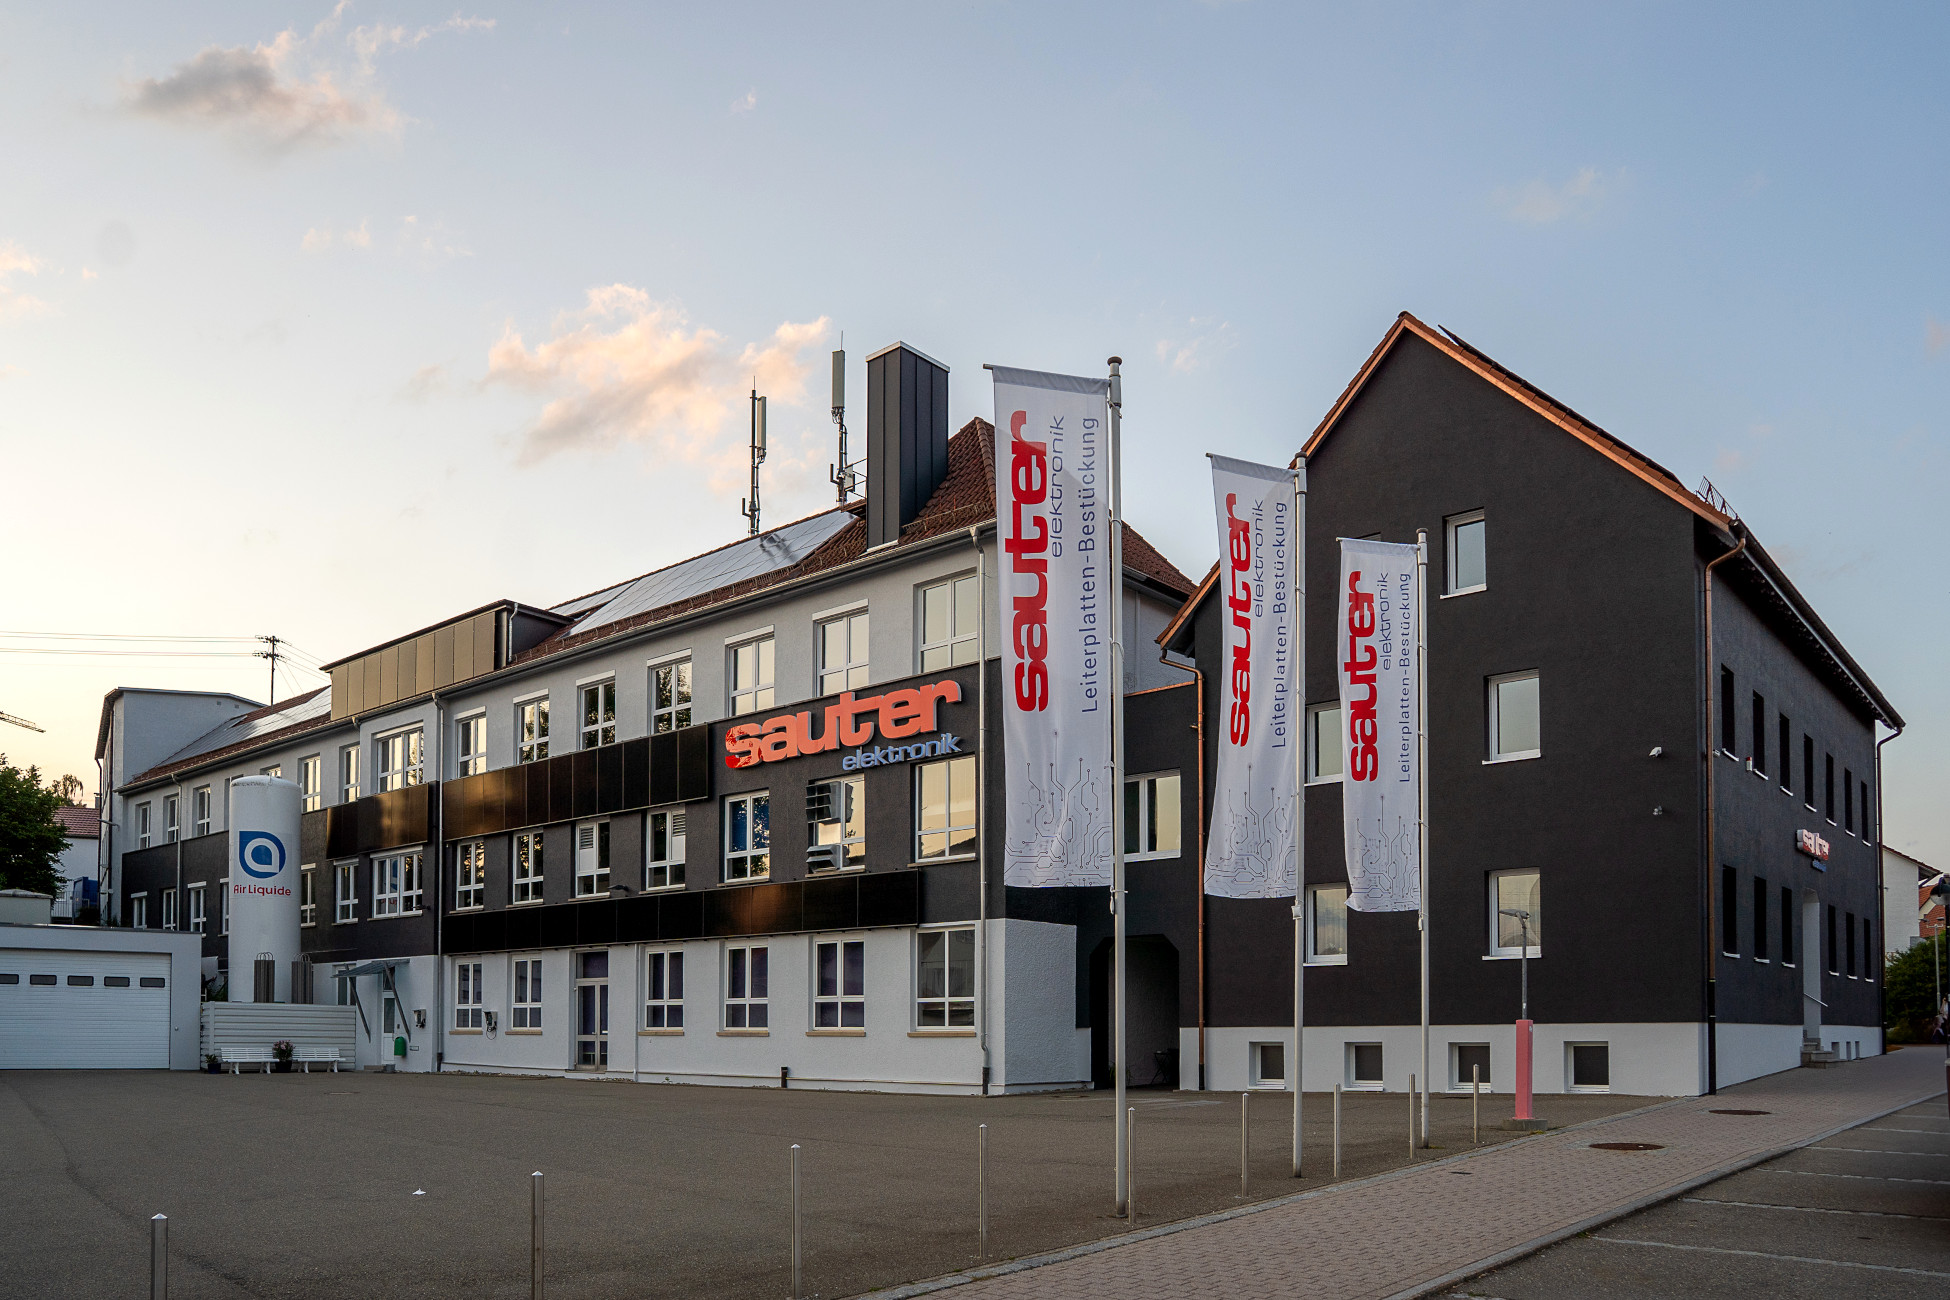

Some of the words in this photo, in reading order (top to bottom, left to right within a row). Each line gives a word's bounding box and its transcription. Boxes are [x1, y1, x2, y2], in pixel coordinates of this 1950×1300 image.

[1005, 410, 1049, 712] sauter
[1049, 416, 1064, 557] elektronik
[1078, 418, 1100, 712] Leiterplatten-Bestückung
[1252, 499, 1264, 617] elektronik
[1226, 493, 1251, 747] sauter
[1271, 502, 1288, 748] Leiterplatten-Bestückung
[1344, 571, 1378, 782] sauter
[1377, 572, 1392, 670] elektronik
[1398, 573, 1411, 782] Leiterplatten-Bestückung
[725, 680, 962, 769] sauter
[842, 732, 963, 771] elektronik
[233, 884, 246, 894] Air
[248, 884, 292, 896] Liquide
